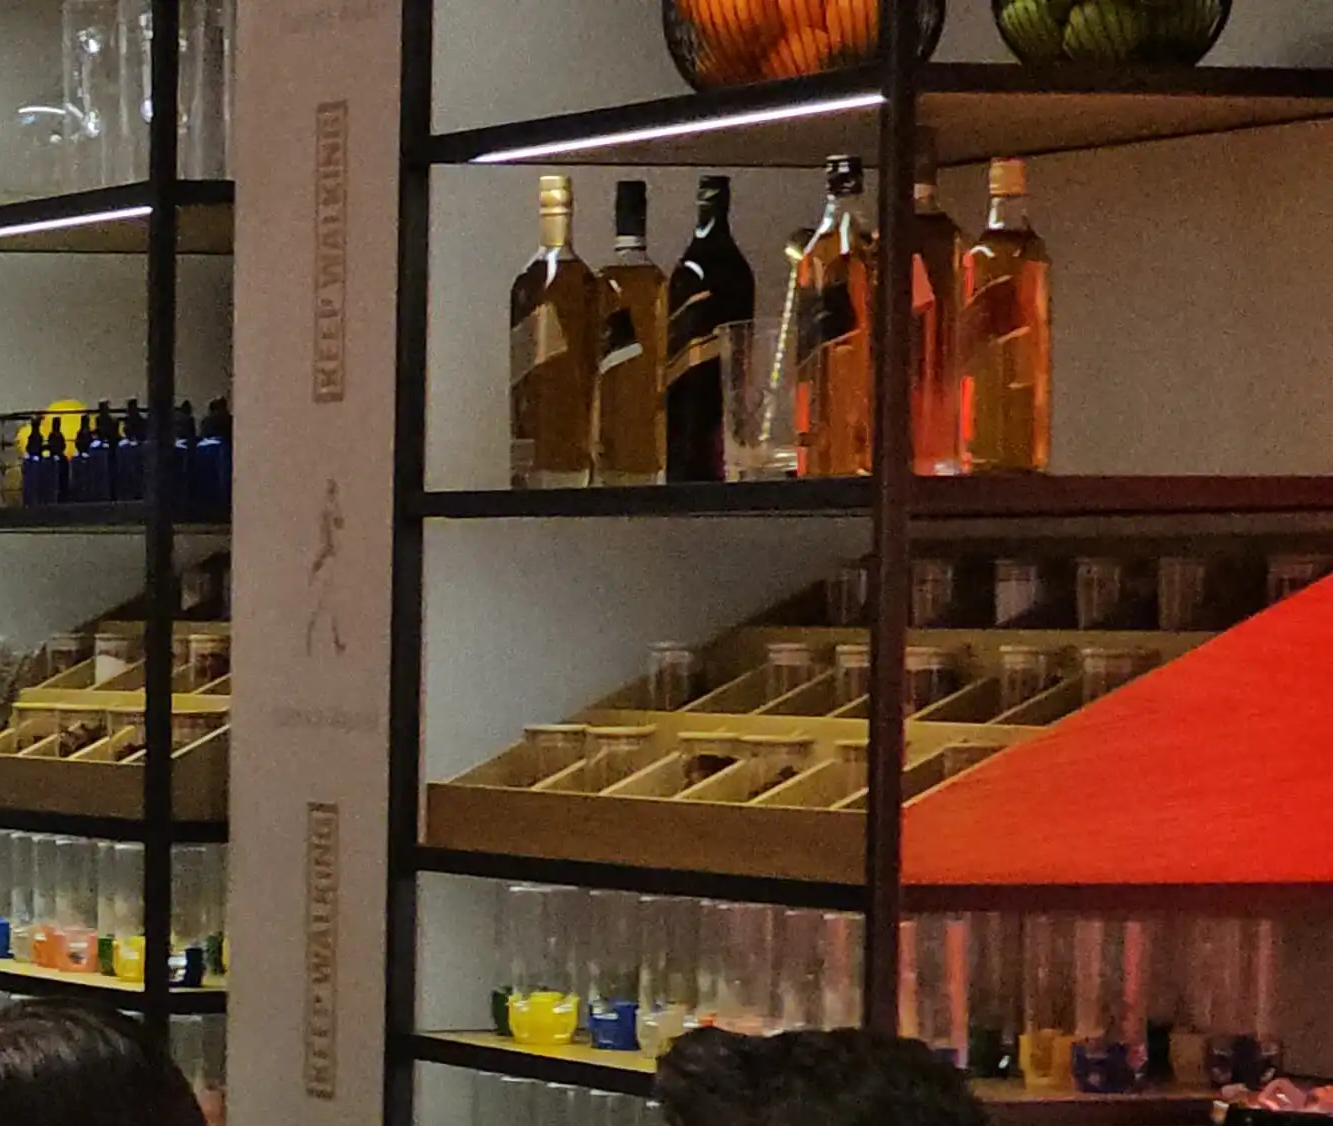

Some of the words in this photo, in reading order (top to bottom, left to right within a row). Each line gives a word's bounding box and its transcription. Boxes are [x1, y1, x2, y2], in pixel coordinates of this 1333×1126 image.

[318, 113, 344, 289] WALKING
[316, 298, 341, 388] KEEP
[311, 816, 335, 986] WALKING
[310, 997, 331, 1084] KEEP
